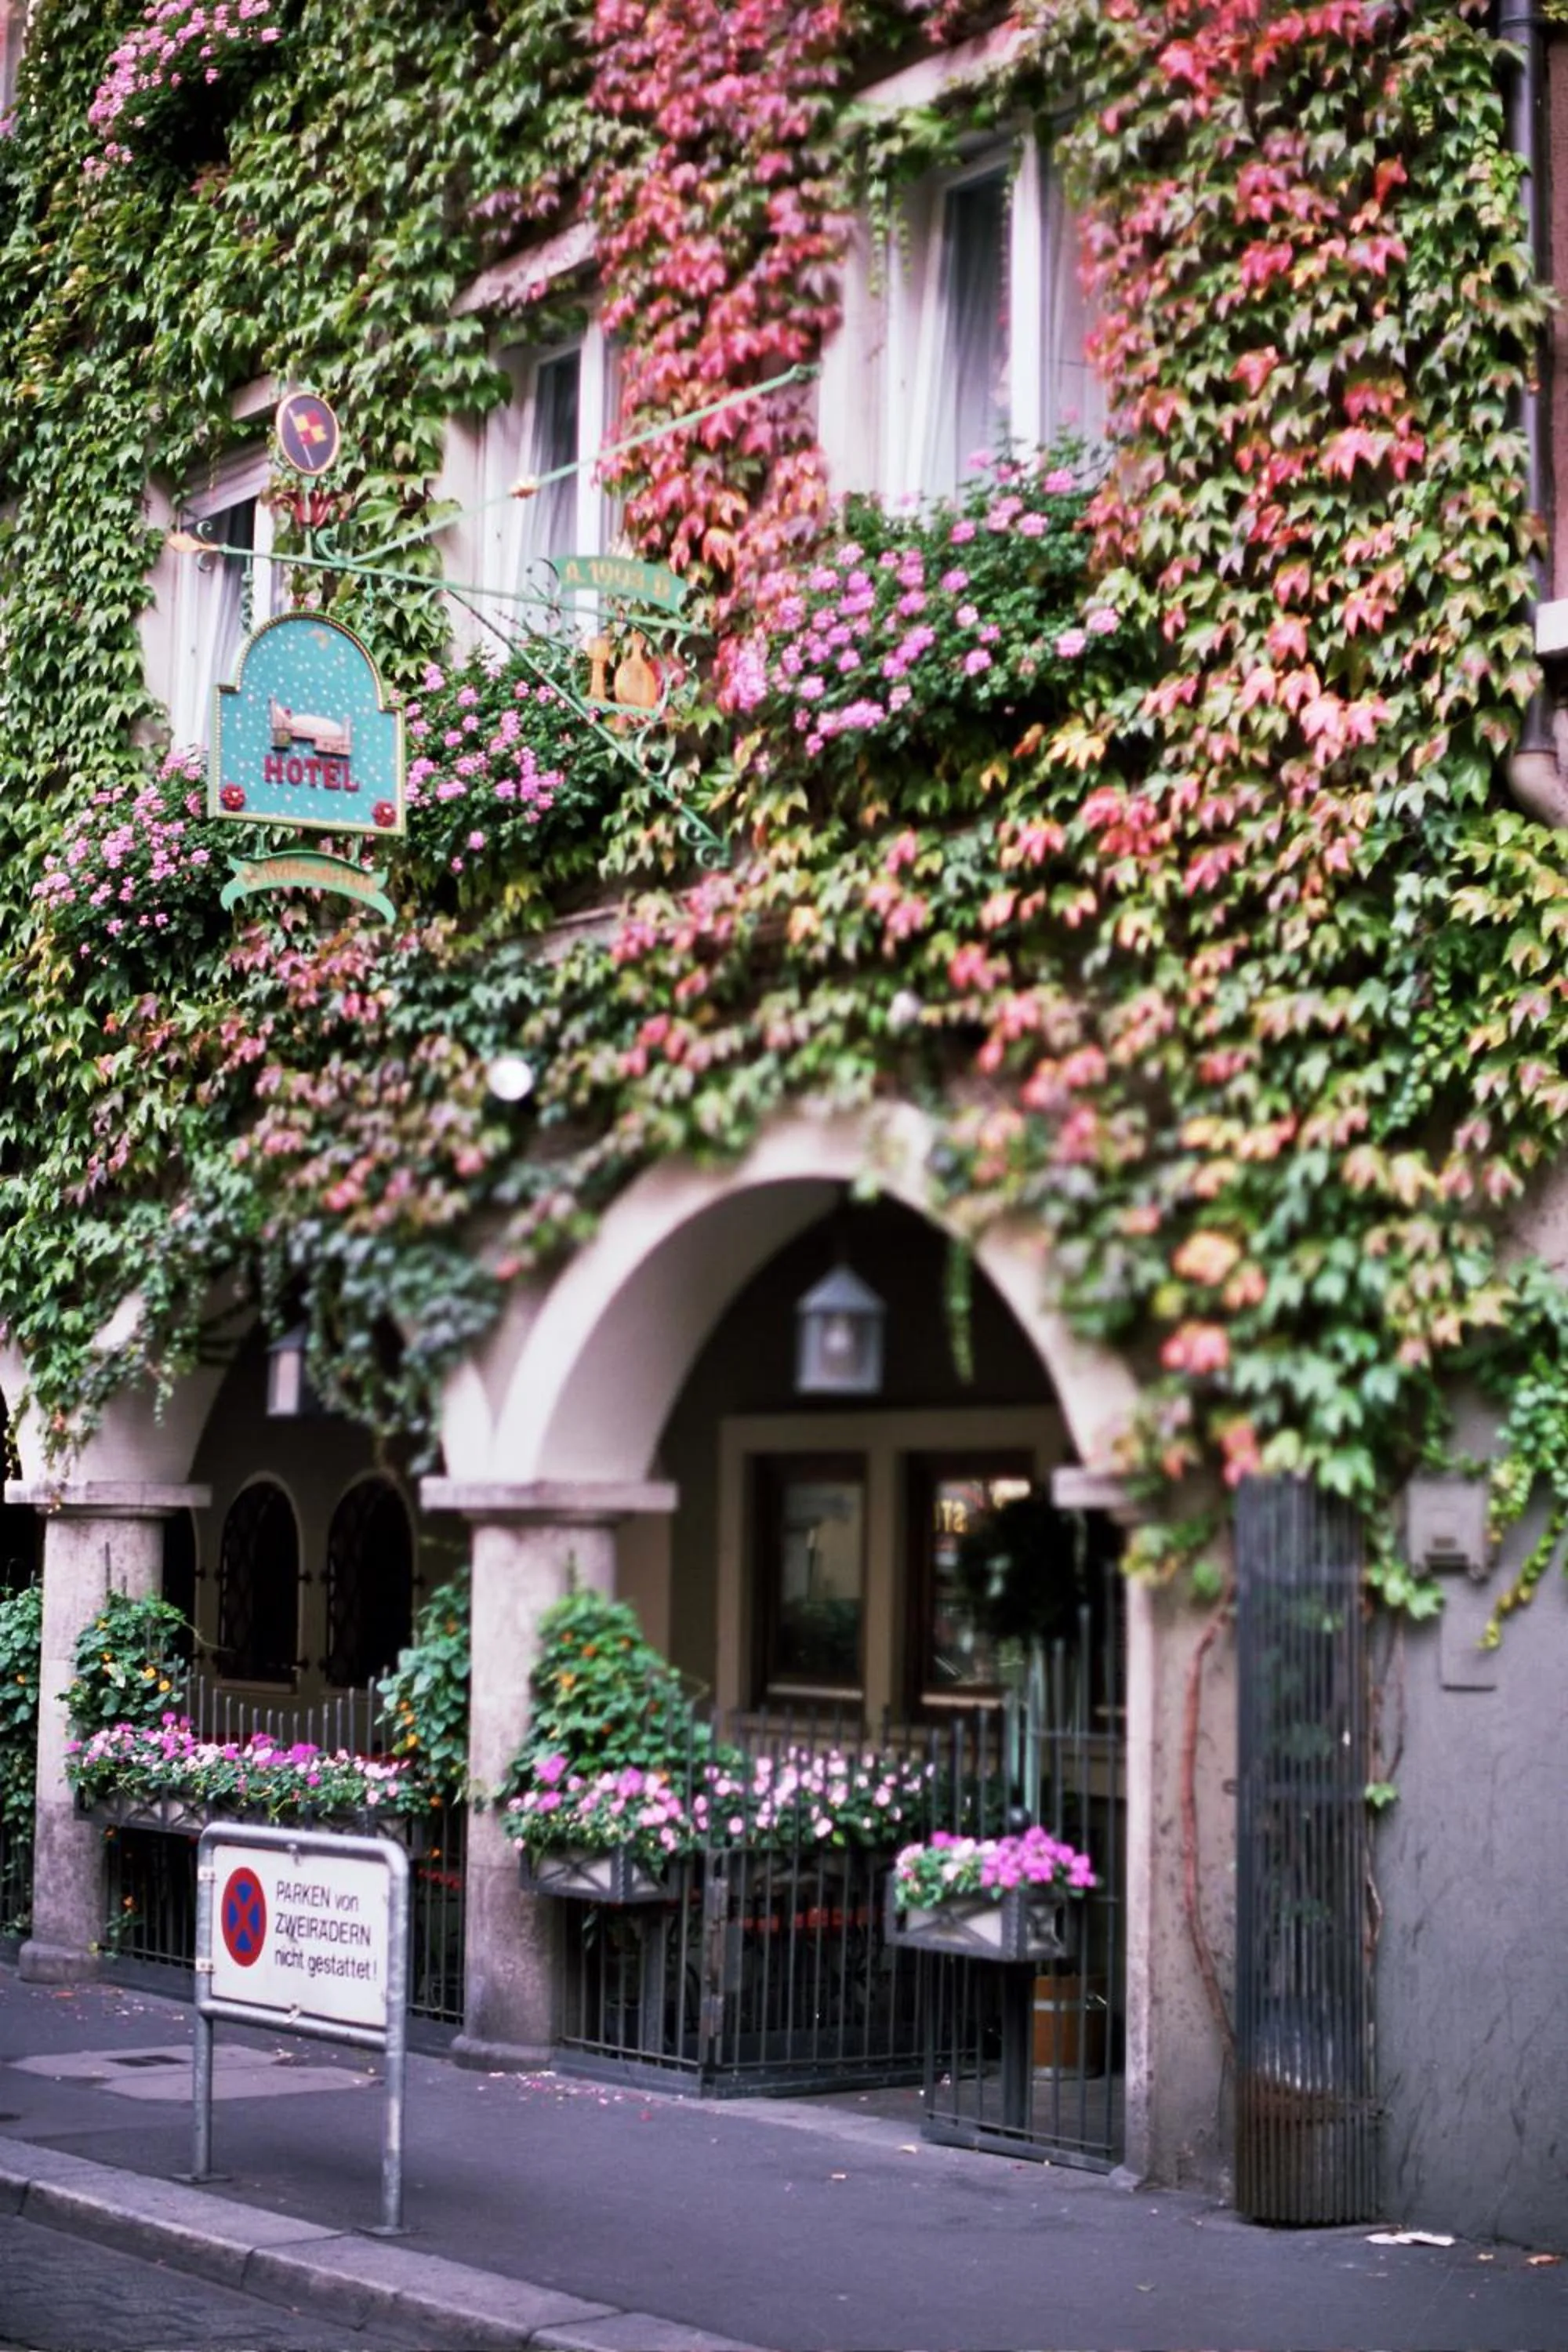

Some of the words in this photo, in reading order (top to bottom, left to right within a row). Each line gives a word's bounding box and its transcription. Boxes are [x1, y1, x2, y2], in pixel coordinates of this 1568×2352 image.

[263, 753, 360, 793] HOTEL
[276, 1880, 331, 1907] PARKEN
[335, 1893, 359, 1912] von
[275, 1911, 372, 1946] ZWEIRÄDERN
[274, 1947, 303, 1969] nicht
